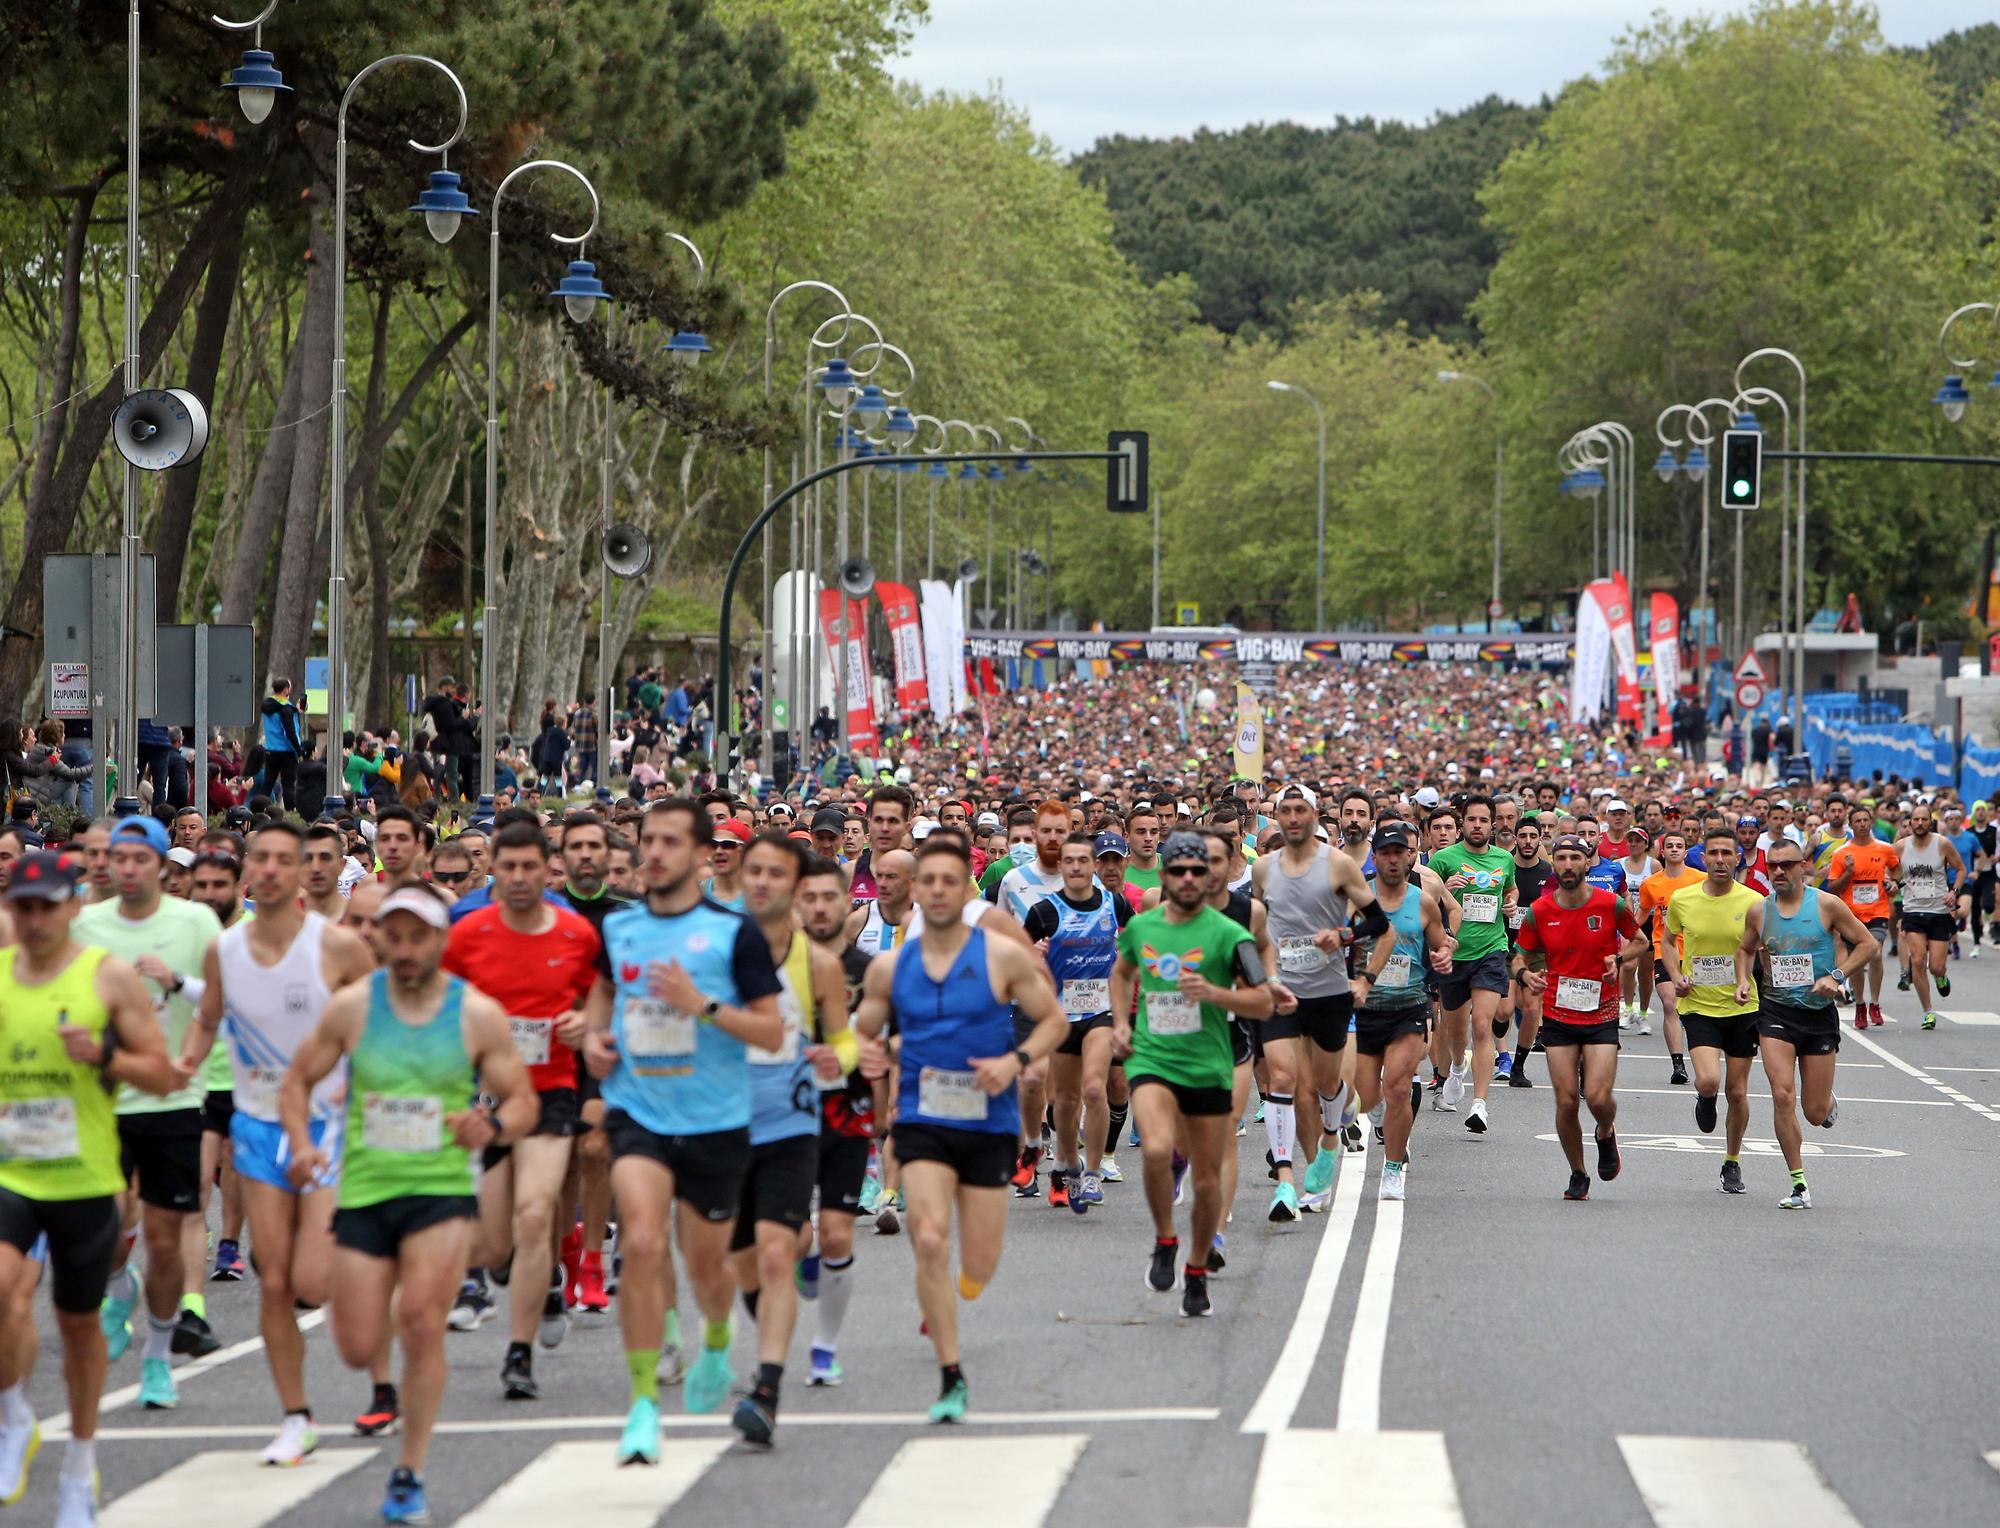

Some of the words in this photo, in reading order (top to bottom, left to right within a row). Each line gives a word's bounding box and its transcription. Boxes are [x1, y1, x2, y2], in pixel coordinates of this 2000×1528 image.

[53, 689, 87, 699] ACUPUNTURA
[1779, 971, 1805, 982] 2422
[1071, 997, 1100, 1008] 6068
